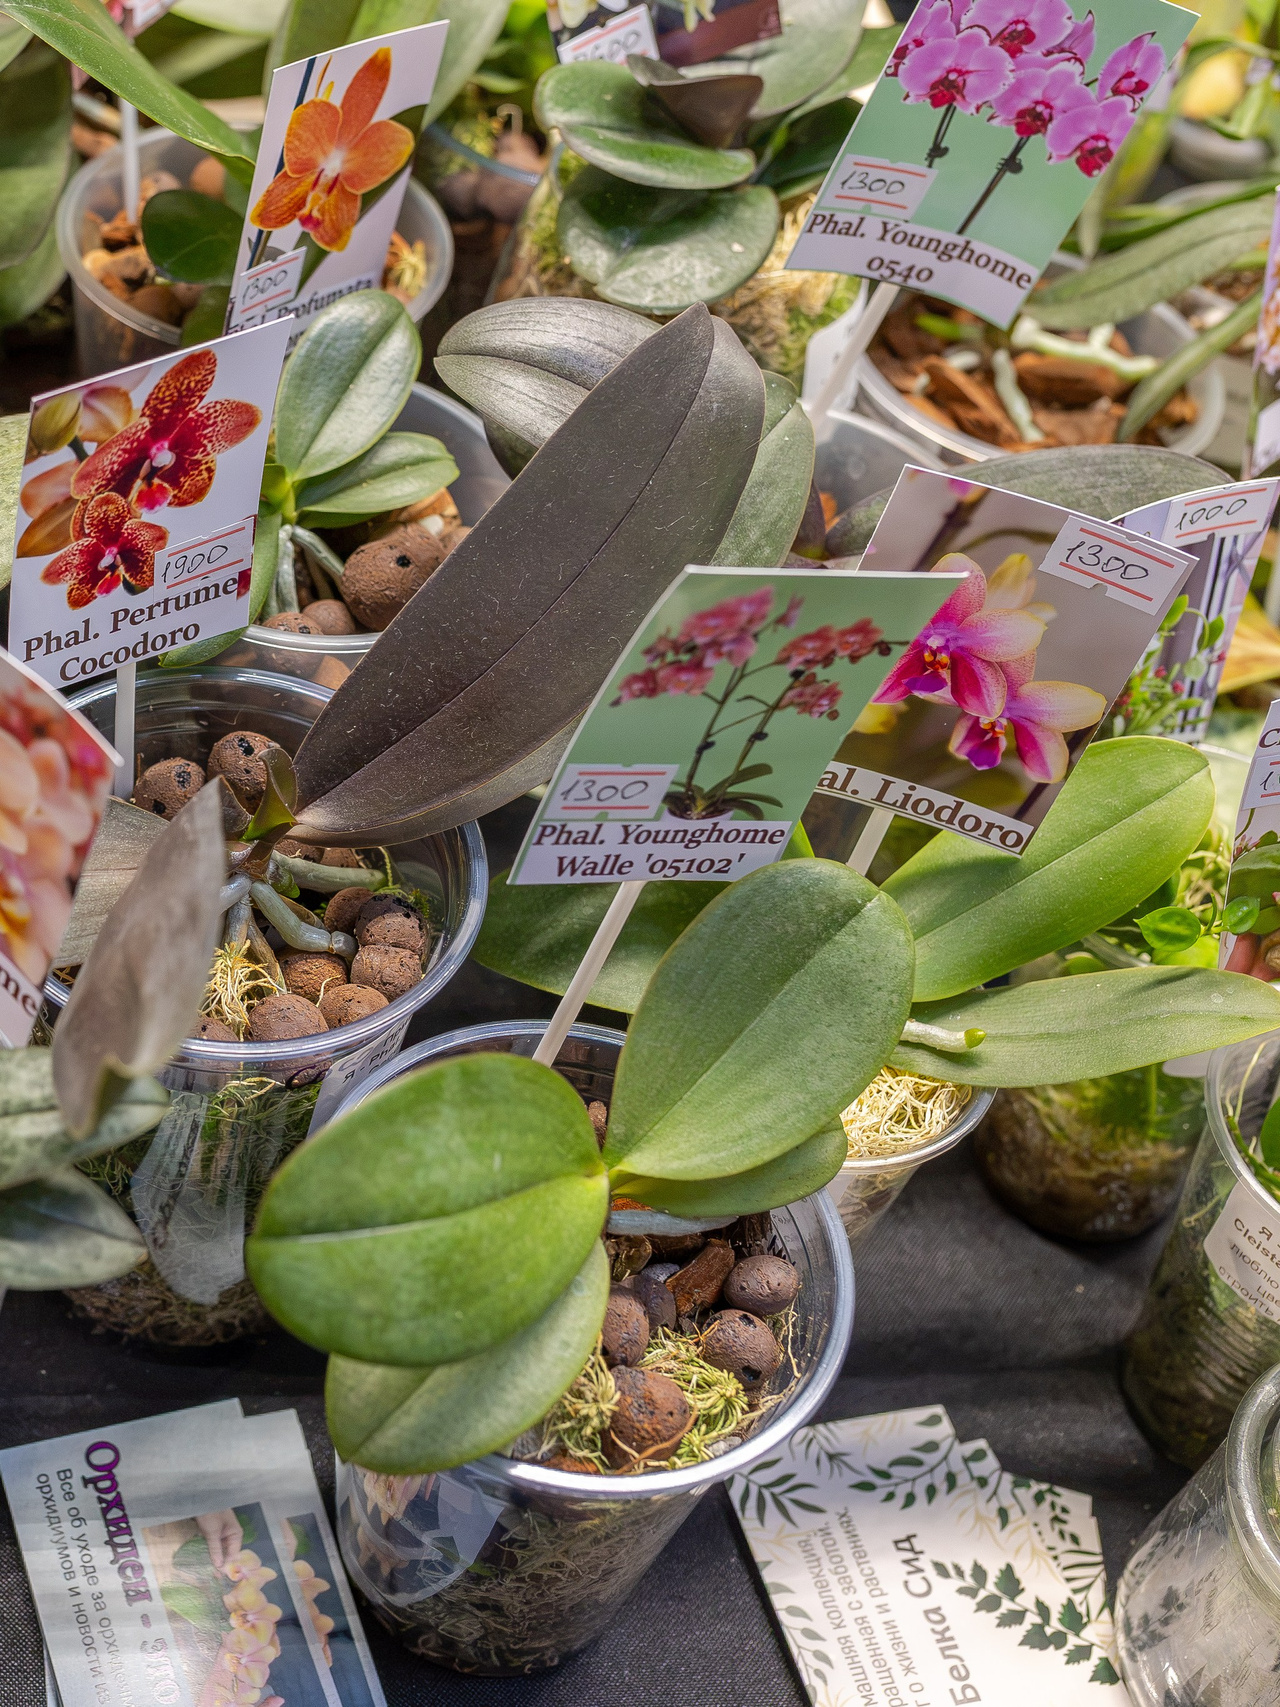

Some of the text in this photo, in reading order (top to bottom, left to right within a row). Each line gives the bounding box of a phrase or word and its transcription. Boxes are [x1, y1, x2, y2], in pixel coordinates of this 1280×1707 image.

[840, 170, 906, 195] 1300
[805, 213, 1034, 291] Phal. Younghome
[865, 255, 935, 286] 0540
[1174, 498, 1248, 531] 1000
[161, 544, 229, 583] 1900
[1066, 540, 1149, 580] 1300
[22, 576, 239, 664] Phal. Perfume
[59, 622, 201, 683] Cocodoro
[560, 779, 649, 802] 1300
[870, 777, 1024, 850] Liodoro
[532, 821, 786, 849] Phal. Younghome
[555, 853, 747, 878] Walle '05102'
[1258, 1226, 1273, 1241] Я
[1230, 1242, 1280, 1290] люблю
[1218, 1265, 1274, 1317] строить
[56, 1468, 76, 1502] Все
[36, 1473, 78, 1582] орхидиумов
[67, 1506, 87, 1529] об
[80, 1441, 153, 1608] Орхидеи
[70, 1532, 100, 1587] уходе
[814, 1520, 858, 1597] заботой.
[835, 1506, 890, 1599] растениях.
[67, 1585, 82, 1598] и
[91, 1592, 107, 1613] за
[847, 1599, 864, 1612] с
[875, 1602, 892, 1615] и
[892, 1532, 982, 1707] Белка Сид
[72, 1602, 105, 1679] новости
[882, 1619, 919, 1678] жизни
[908, 1681, 925, 1695] о
